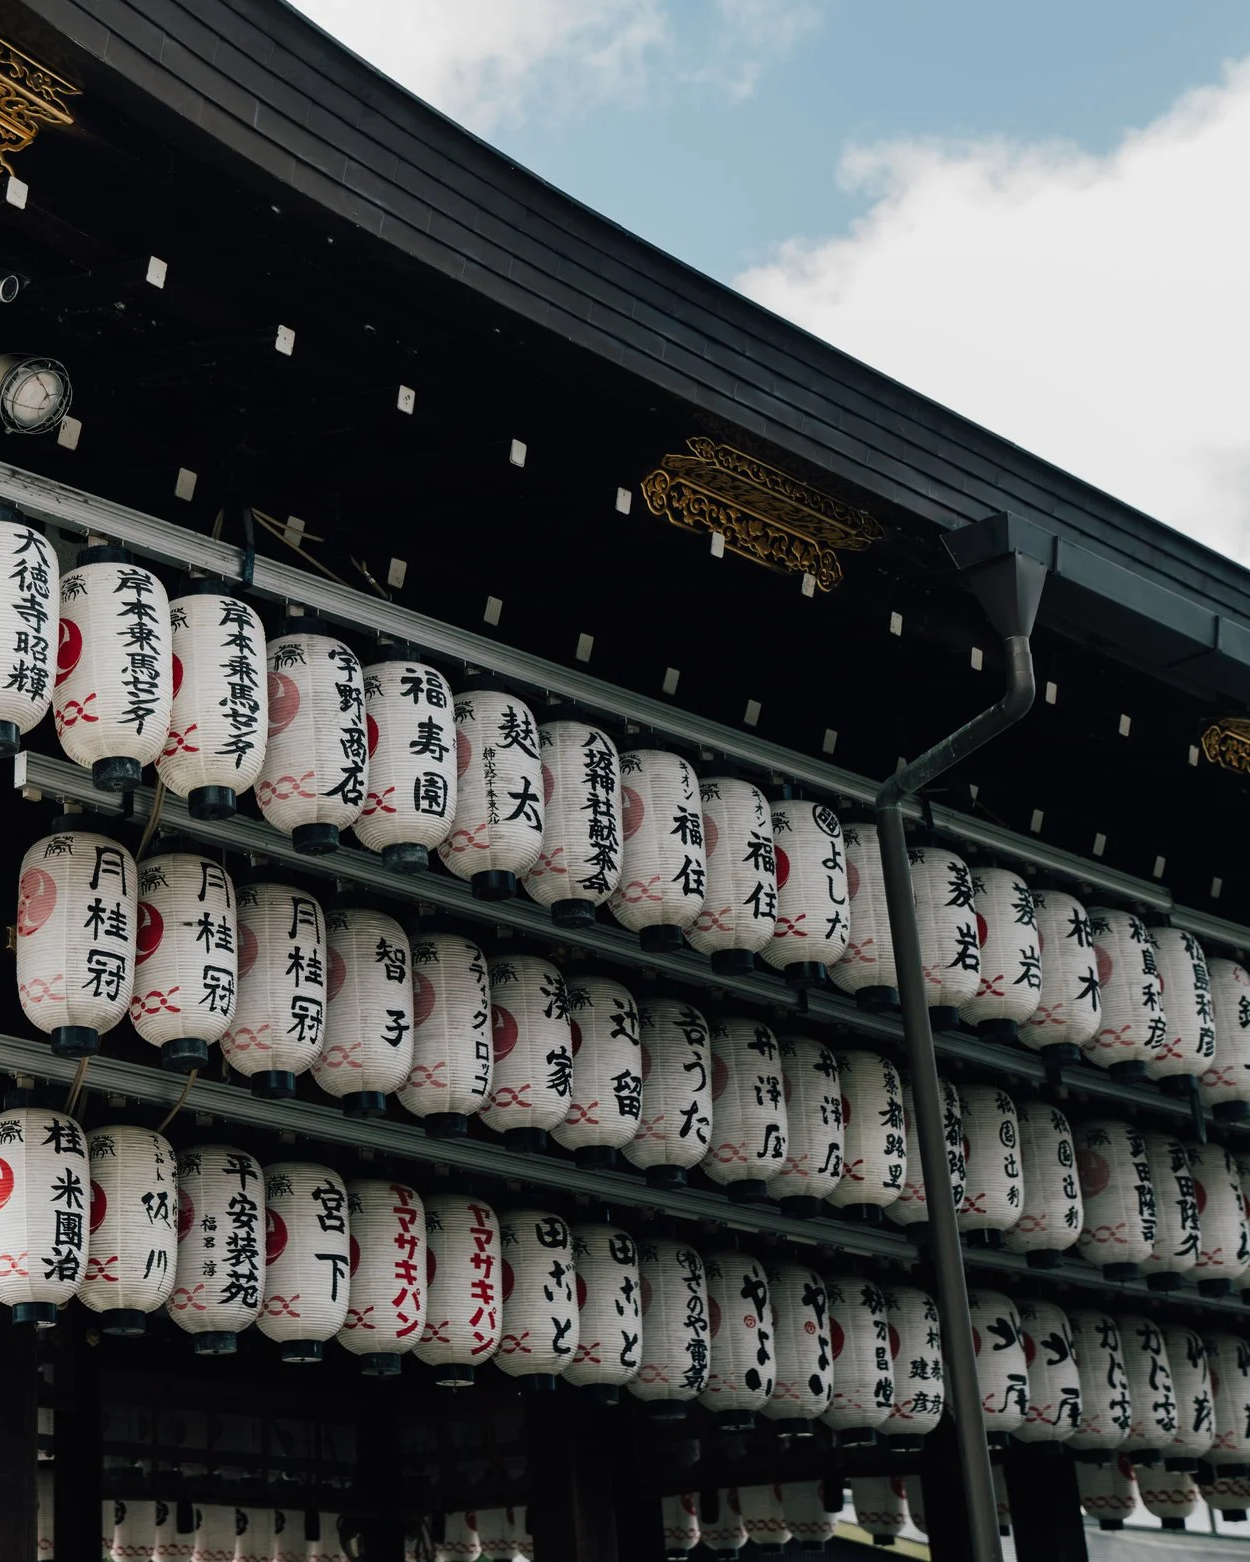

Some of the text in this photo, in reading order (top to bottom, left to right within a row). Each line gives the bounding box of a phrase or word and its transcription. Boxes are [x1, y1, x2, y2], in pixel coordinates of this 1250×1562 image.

[2, 529, 51, 701] 大徳寺昭輝
[113, 568, 161, 736] 岸本乗馬センター
[214, 600, 259, 769] 岸本乗馬センター
[318, 645, 367, 806] 宇野商店
[400, 667, 450, 818] 福寿園
[576, 731, 620, 895] 八坂神社献茶会
[82, 846, 129, 1002] 月桂冠
[196, 861, 235, 1016] 月桂冠
[286, 896, 324, 1045] 月桂冠
[376, 937, 410, 1048] 智子
[944, 861, 980, 974] 菱岩
[1011, 882, 1042, 991] 菱岩
[610, 999, 641, 1121] 辻留
[674, 1006, 711, 1145] 吉うた
[41, 1118, 85, 1282] 桂米團治
[218, 1153, 259, 1308] 平安装苑
[312, 1180, 349, 1302] 宮下
[390, 1184, 420, 1339] ヤマザキパン
[457, 1203, 497, 1356] ヤマザキパン
